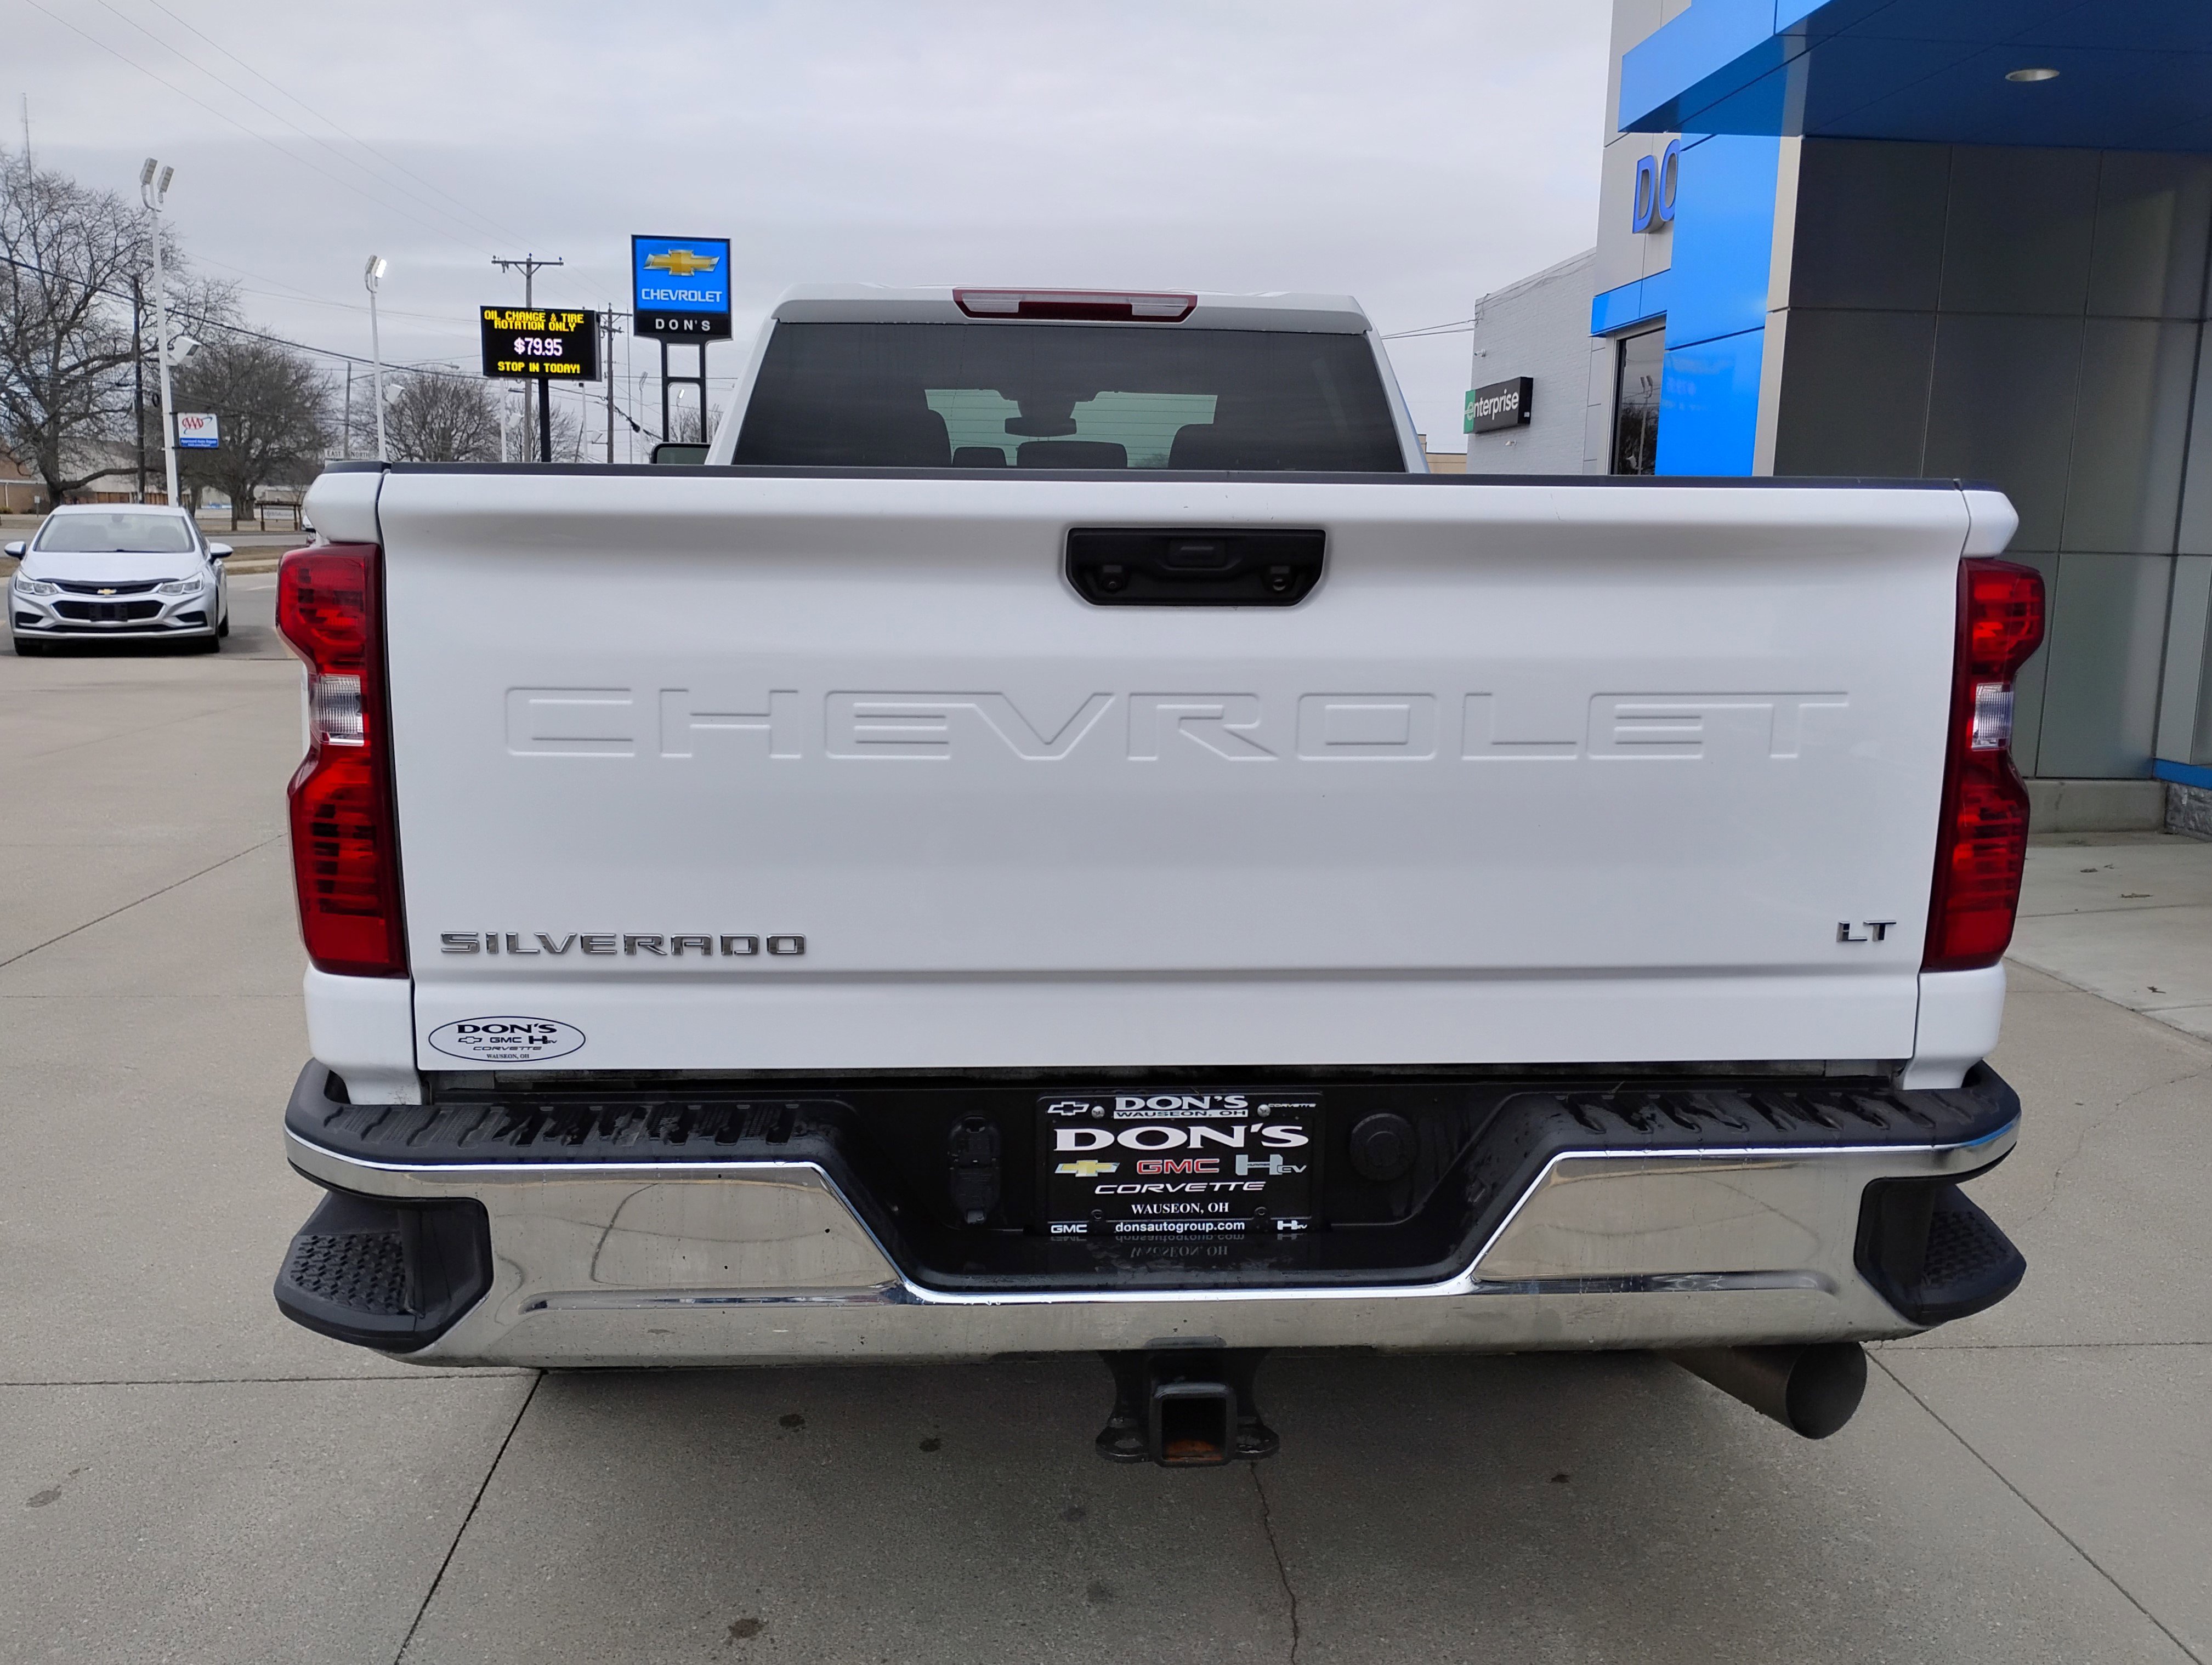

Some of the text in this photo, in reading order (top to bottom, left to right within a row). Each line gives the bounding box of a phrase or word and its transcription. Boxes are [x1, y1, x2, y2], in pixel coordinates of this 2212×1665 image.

[642, 288, 722, 302] CHEVROLET
[484, 310, 585, 323] OIL CHANGE & TIRE
[494, 320, 576, 332] ROTATION ONLY
[655, 319, 711, 332] DON'S
[514, 337, 563, 356] $79.95
[497, 361, 581, 373] STOP IN TODAY!
[1465, 389, 1519, 420] enterprise
[505, 686, 1848, 762] CHEVROLET
[1836, 920, 1897, 942] LT
[441, 931, 807, 956] SILVERADO
[457, 1023, 557, 1034] DON'S
[1115, 1096, 1248, 1110] DON'S
[1054, 1123, 1309, 1151] DON'S
[1136, 1158, 1220, 1174] GMC
[1094, 1181, 1266, 1194] CORVETTE
[1131, 1202, 1229, 1215] WAUSEON, OH
[1051, 1224, 1087, 1233] GMC
[1115, 1221, 1245, 1232] donsautogroup.com
